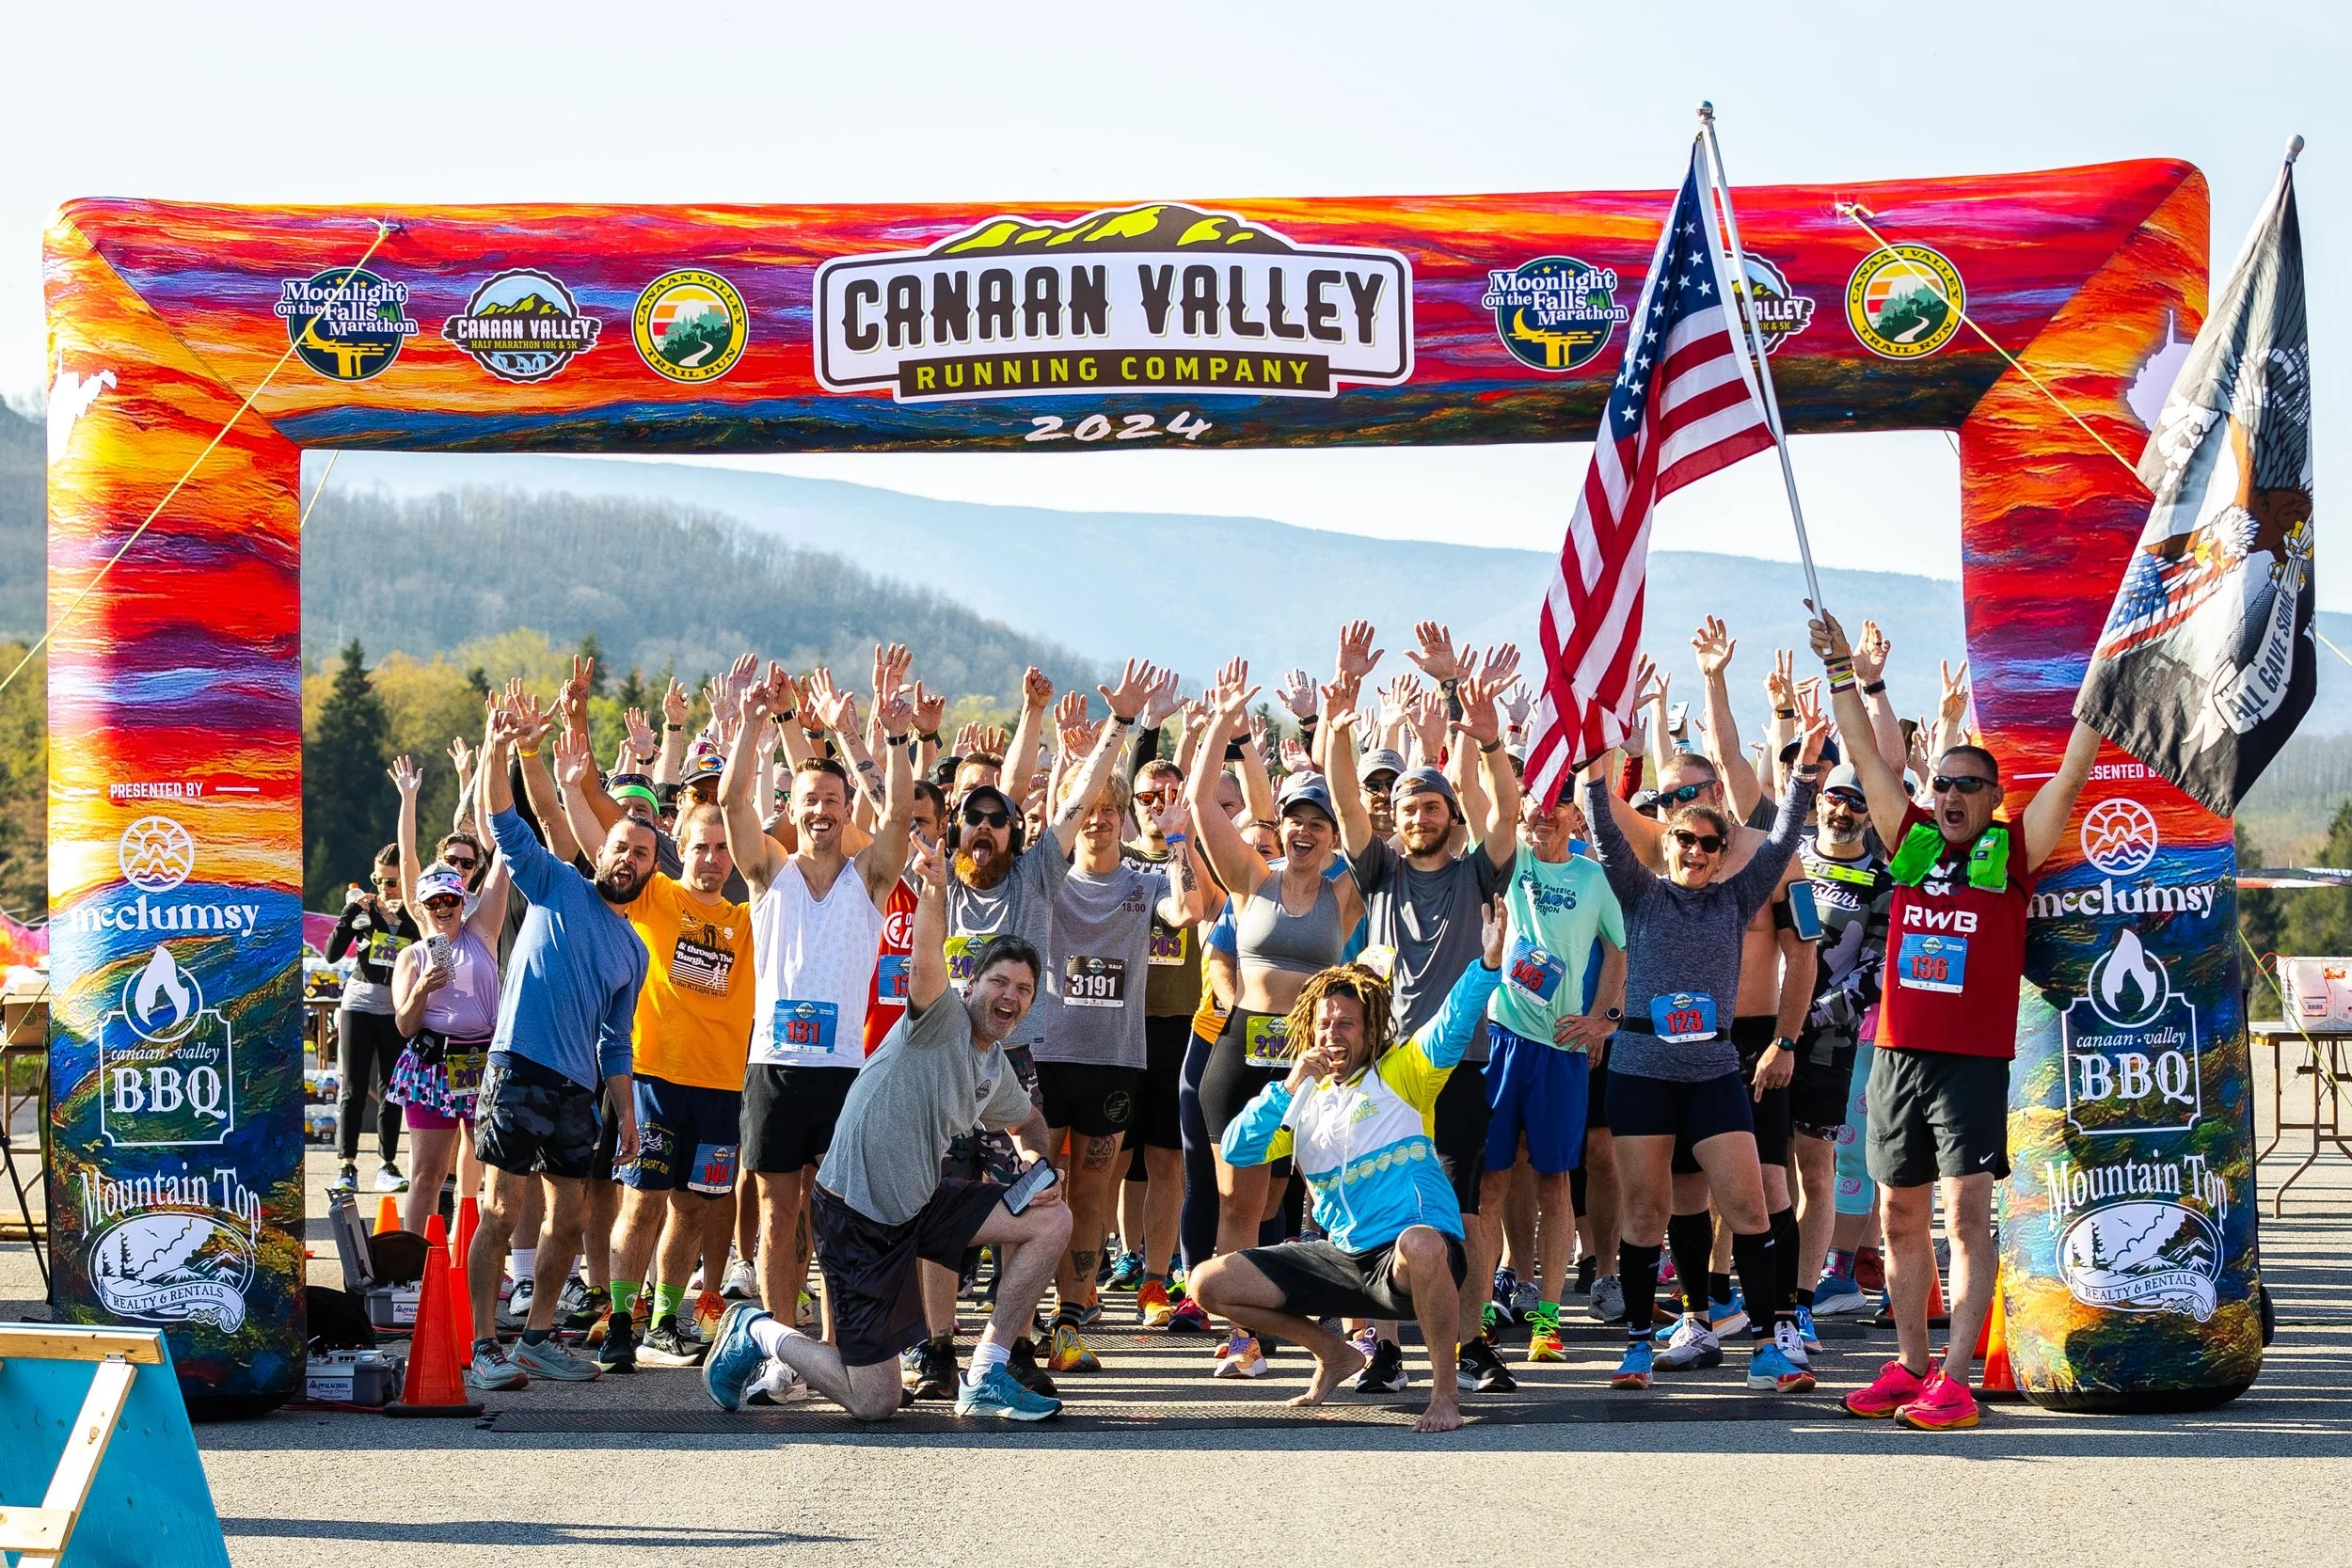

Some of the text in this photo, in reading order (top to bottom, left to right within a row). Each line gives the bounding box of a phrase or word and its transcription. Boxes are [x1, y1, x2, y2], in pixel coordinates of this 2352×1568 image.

[1492, 270, 1614, 294] Moonlight
[1910, 249, 1960, 300] VALLEY
[284, 281, 405, 307] Moonlight
[638, 274, 743, 327] CANAAN VALLEY
[1485, 291, 1587, 310] on the Falls
[277, 301, 378, 322] on the Falls
[842, 264, 1388, 352] CANAAN VALLEY
[1537, 306, 1626, 325] Marathon
[328, 318, 416, 336] Marathon
[457, 319, 591, 340] CANAAN VALLEY
[1861, 321, 1953, 353] TRAIL RUN
[471, 341, 578, 349] HALF MARATHON 10K & 5K
[647, 347, 736, 377] TRAIL RUN
[916, 356, 1309, 389] RUNNING COMPANY
[1025, 411, 1213, 442] 2024
[2225, 586, 2296, 721] ALL GAVE SOME
[2088, 763, 2144, 781] ESENTED
[110, 783, 204, 799] PRESENTED BY
[1543, 884, 1577, 896] AMERICA
[2026, 878, 2216, 919] mcclumsy
[69, 895, 261, 937] mcclumsy
[1122, 902, 1146, 913] 18.00
[1902, 904, 1979, 933] RWB
[677, 942, 734, 963] & through The
[1149, 936, 1182, 957] 203
[949, 955, 976, 978] 20
[1511, 958, 1547, 990] 145
[1910, 955, 1948, 981] 136
[1072, 974, 1116, 997] 3191
[786, 1020, 820, 1044] 131
[1665, 1008, 1704, 1034] 123
[1254, 1035, 1291, 1058] 219
[2076, 1027, 2186, 1049] canaan valley
[111, 1042, 220, 1065] canaan valley
[2076, 1051, 2195, 1104] BBQ
[112, 1066, 227, 1119] BBQ
[704, 1163, 729, 1185] 144
[2044, 1148, 2229, 1236] Mountain Top
[81, 1163, 262, 1249] Mountain Top
[113, 1285, 225, 1309] REALTY & RENTALS
[2085, 1275, 2198, 1301] REALTY & RENTALS
